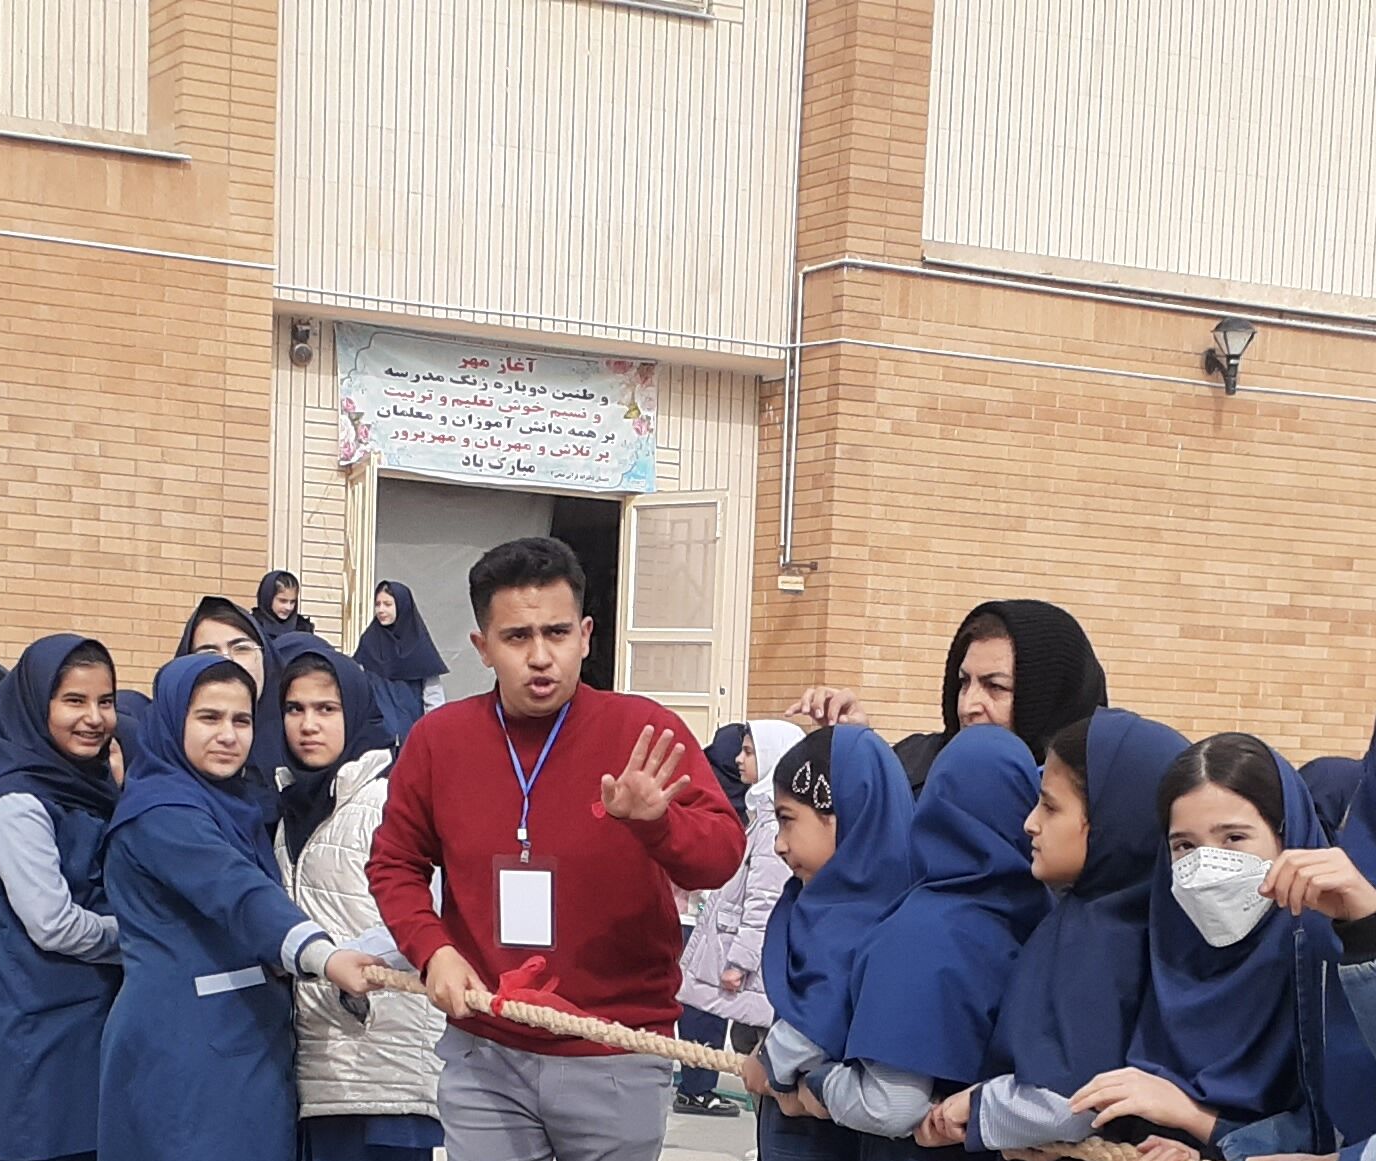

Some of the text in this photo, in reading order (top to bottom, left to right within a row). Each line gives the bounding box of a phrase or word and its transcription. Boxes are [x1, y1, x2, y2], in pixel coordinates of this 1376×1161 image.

[458, 356, 537, 374] آغاز مهر
[384, 367, 445, 383] مدرسه
[493, 380, 547, 397] دوباره
[552, 388, 595, 401] طنین
[384, 386, 602, 424] و نسیم خوش تعلیم و تربیت
[599, 396, 609, 406] و
[376, 405, 433, 420] معلمان
[439, 415, 448, 425] و
[452, 414, 515, 430] آموزان
[519, 420, 563, 434] دانش
[568, 427, 597, 438] همه
[461, 437, 471, 447] و
[474, 436, 532, 452] مهربان
[537, 445, 546, 455] و
[550, 444, 591, 457] تلاش
[462, 454, 536, 476] مبارک باد
